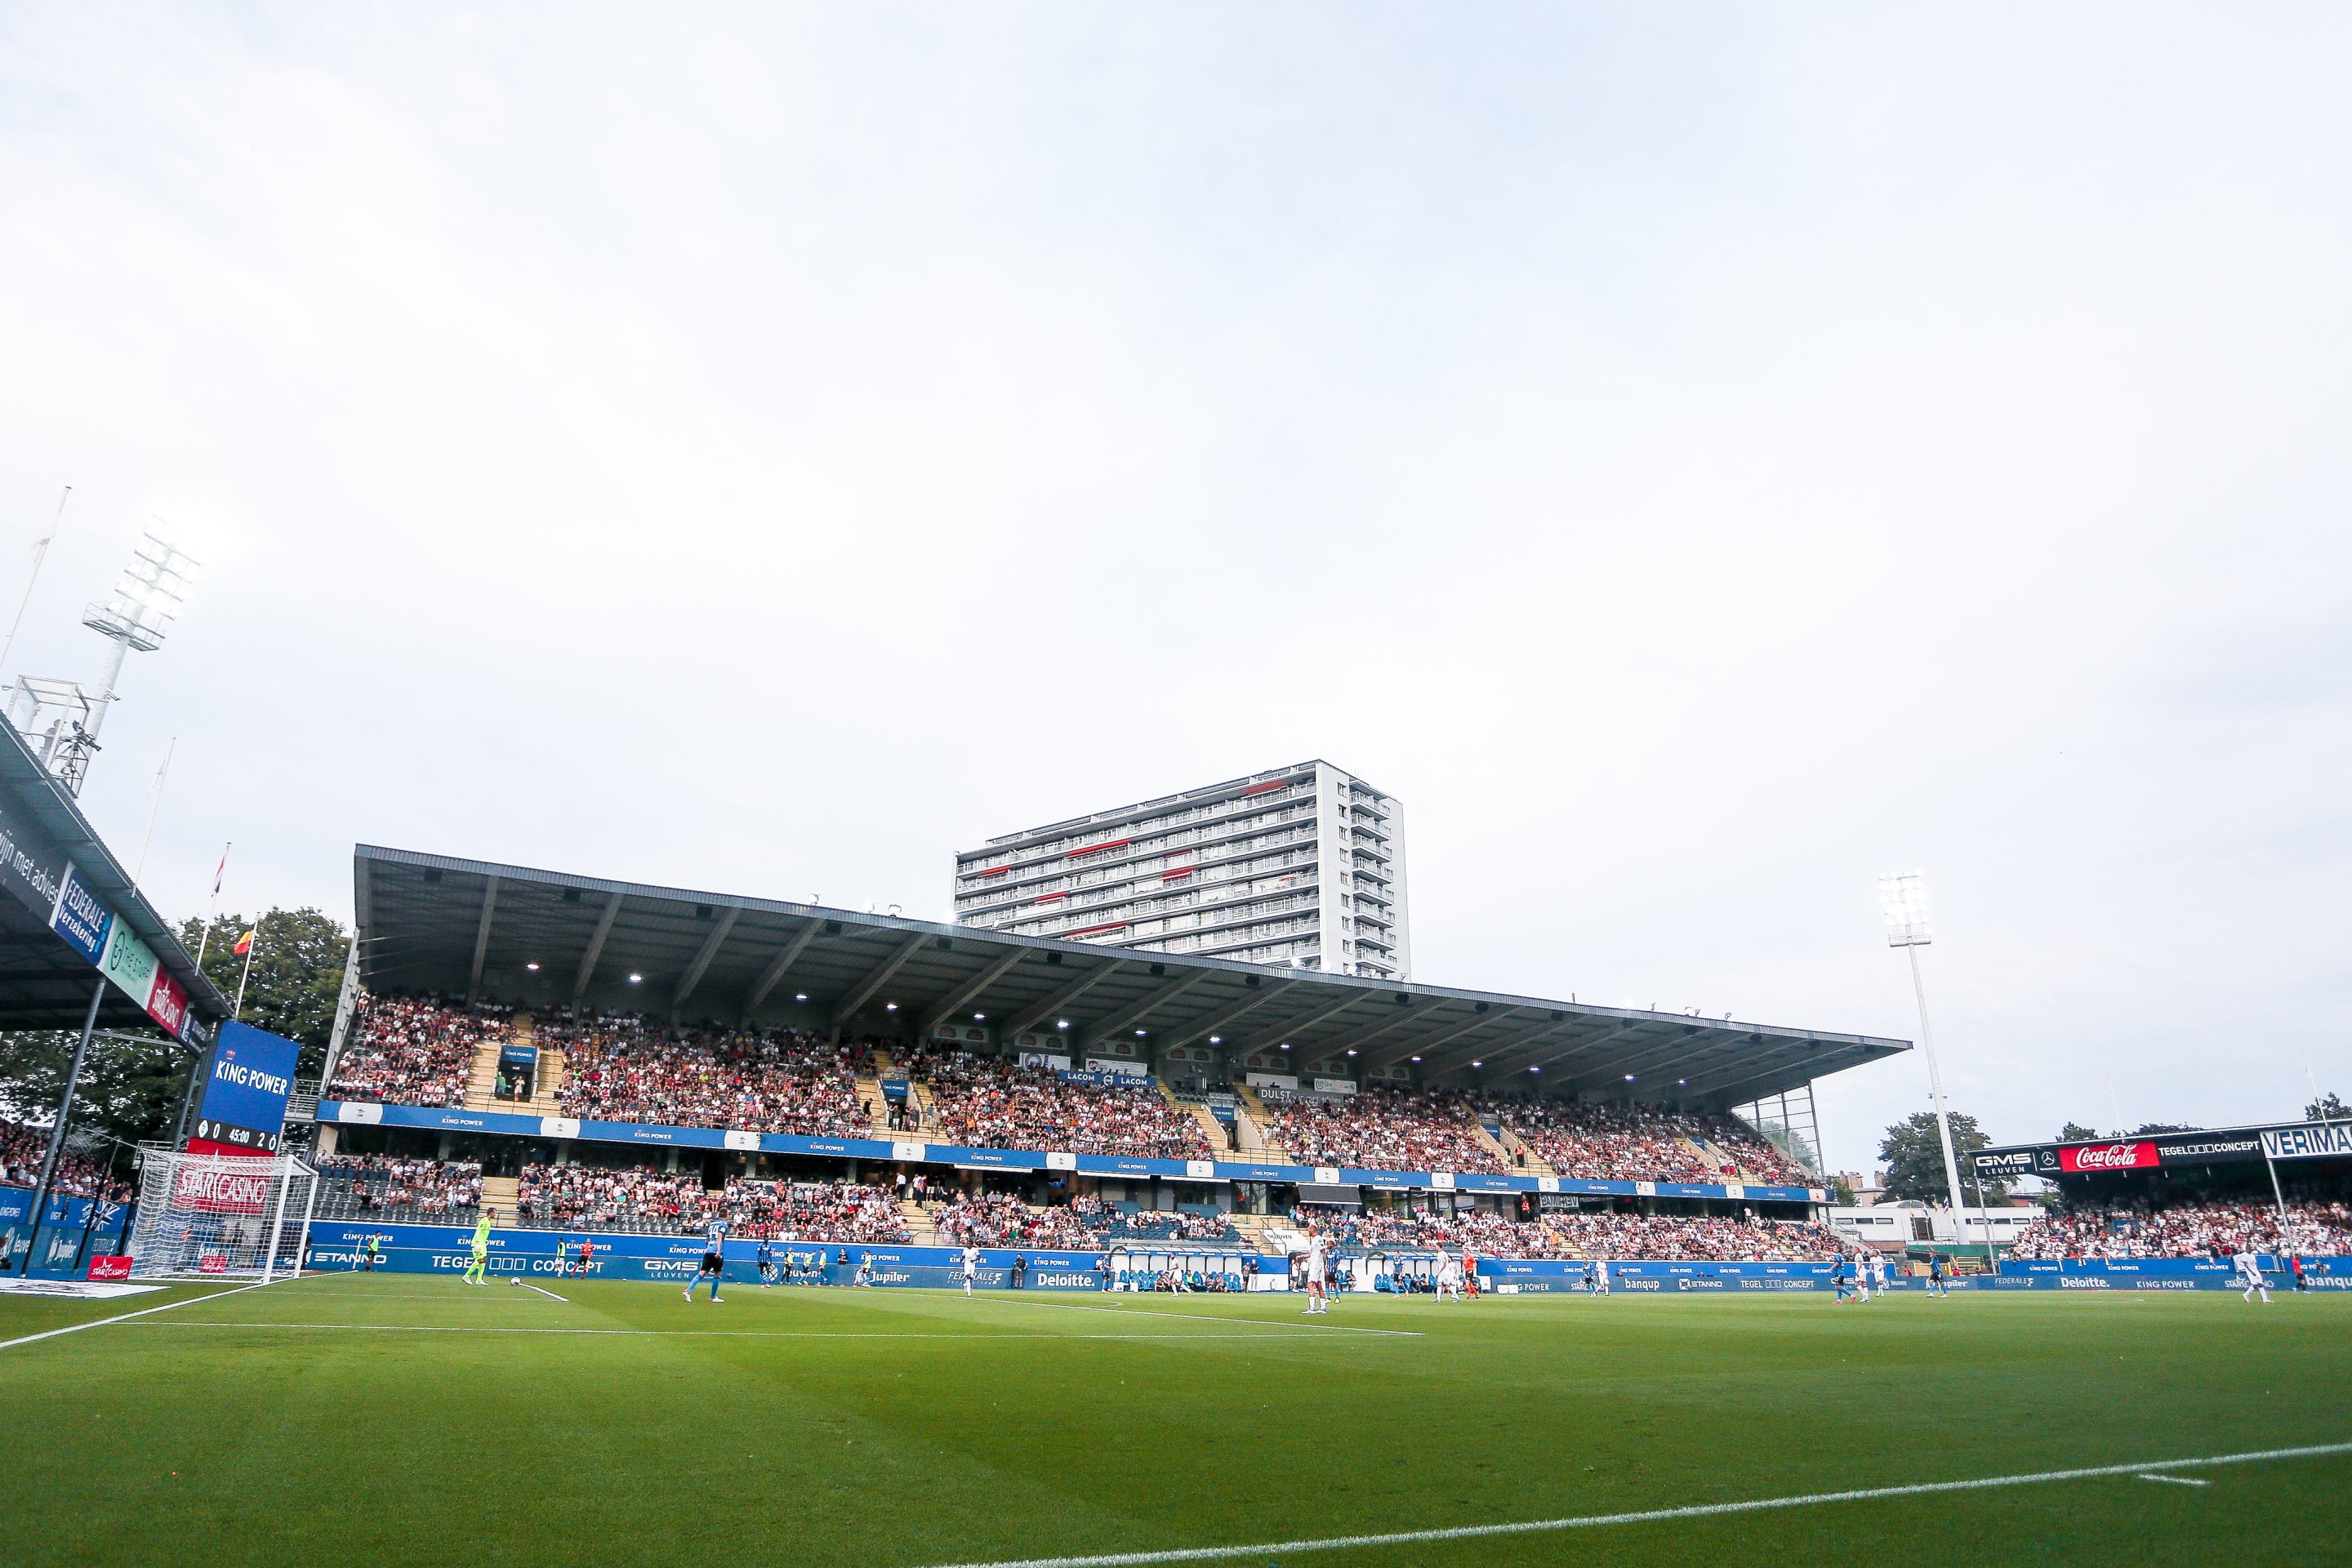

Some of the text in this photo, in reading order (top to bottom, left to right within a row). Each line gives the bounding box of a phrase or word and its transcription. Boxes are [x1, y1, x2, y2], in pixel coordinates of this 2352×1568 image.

[0, 829, 60, 905] ijn met advies
[64, 879, 105, 933] FEDERALE
[58, 904, 96, 952] Verzekering
[216, 1060, 287, 1096] KING POWER
[1067, 1072, 1095, 1081] LACOM
[1120, 1077, 1147, 1086] LACOM
[1261, 1089, 1291, 1099] DULST
[212, 1123, 220, 1139] 0
[229, 1129, 250, 1143] 45:00
[256, 1132, 265, 1147] 2
[2158, 1141, 2260, 1156] TEGEL CONCEPT
[1976, 1152, 2032, 1167] GMS
[2075, 1143, 2137, 1169] Coca-Cola
[1985, 1166, 2025, 1175] LEUVEN
[342, 1232, 363, 1241] KING
[708, 1224, 719, 1239] 44
[457, 1237, 506, 1247] KIN OWER
[314, 1252, 387, 1264] STANNO
[432, 1255, 479, 1269] TEGE
[644, 1260, 699, 1271] GMS
[868, 1270, 911, 1284] Jupiler
[1037, 1272, 1096, 1287] Deloitte.
[1624, 1278, 1659, 1290] banqup
[2060, 1277, 2110, 1288] Deloitte.
[2305, 1274, 2352, 1290] banqu
[1525, 1283, 1549, 1291] POWER
[1740, 1280, 1815, 1289] TEGEL CONCEPT
[2136, 1281, 2195, 1289] KING POWER
